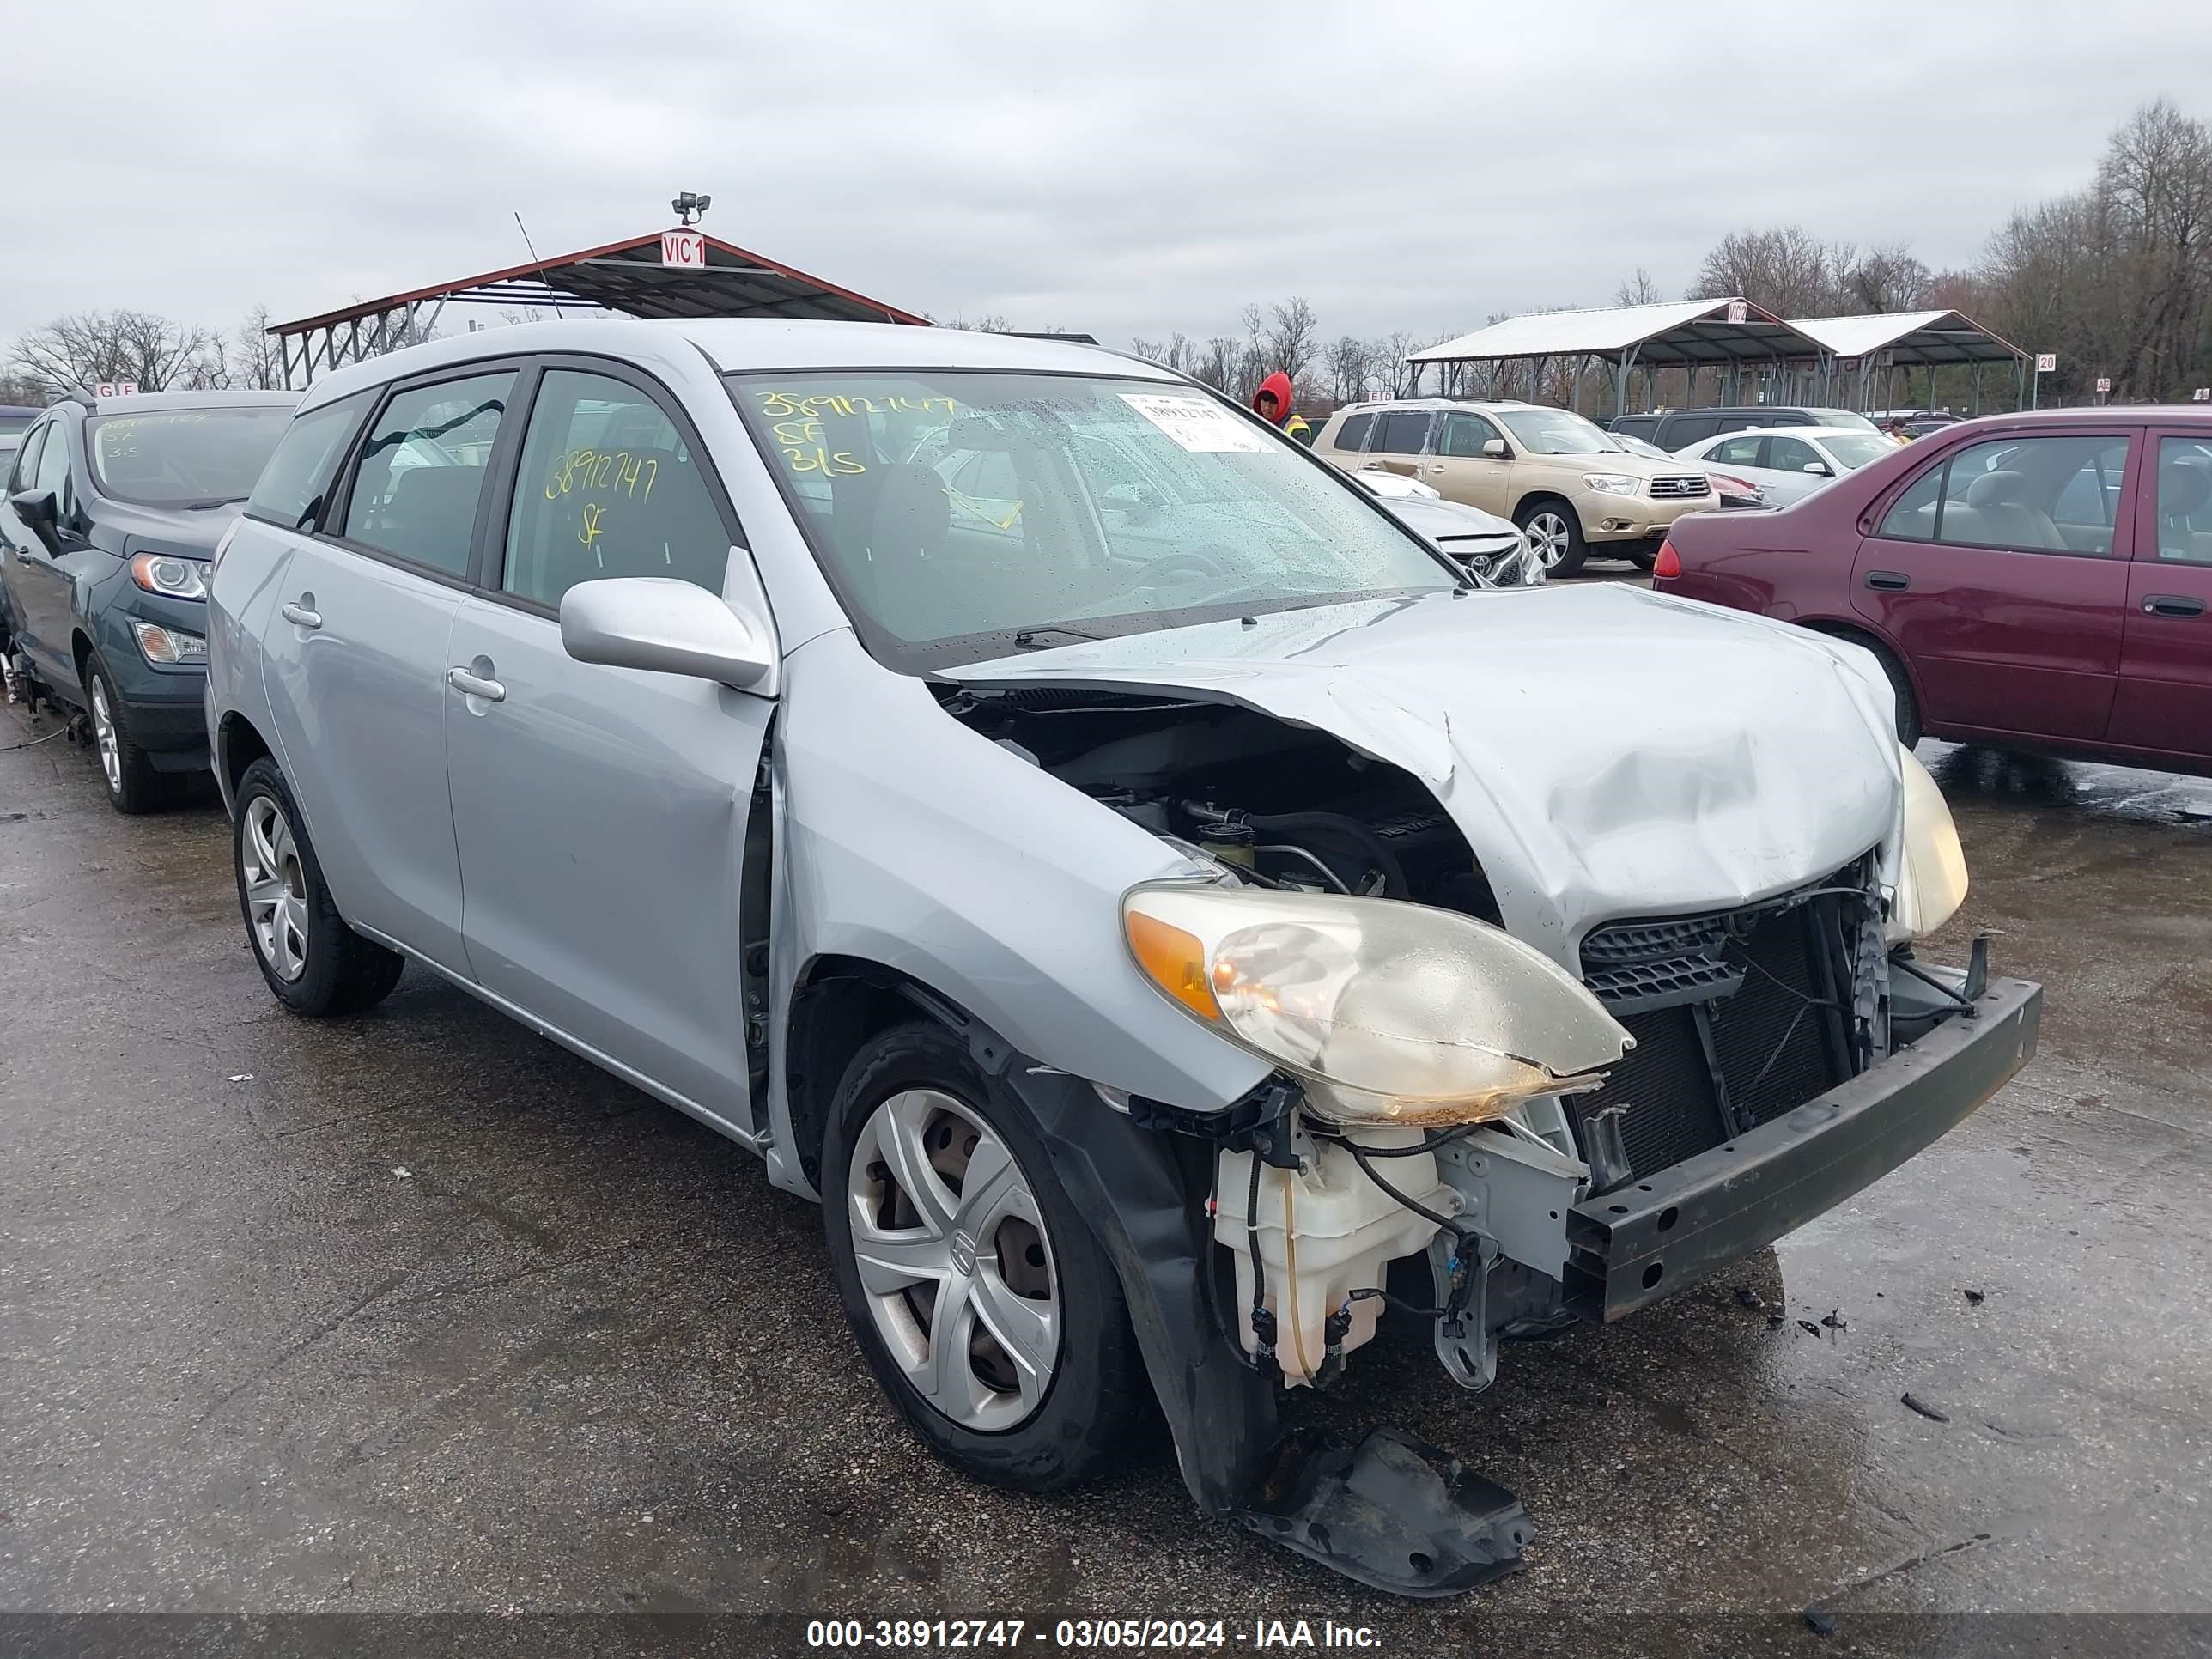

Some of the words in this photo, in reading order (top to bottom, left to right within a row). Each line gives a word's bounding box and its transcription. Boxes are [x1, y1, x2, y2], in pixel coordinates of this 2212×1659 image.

[663, 236, 691, 263] VIC
[695, 239, 703, 264] 1
[2040, 356, 2054, 368] 20
[100, 386, 112, 397] G
[124, 385, 133, 395] F
[1371, 392, 1378, 401] E
[1385, 392, 1392, 401] D
[755, 392, 957, 417] 38912747
[545, 450, 658, 505] 38912747
